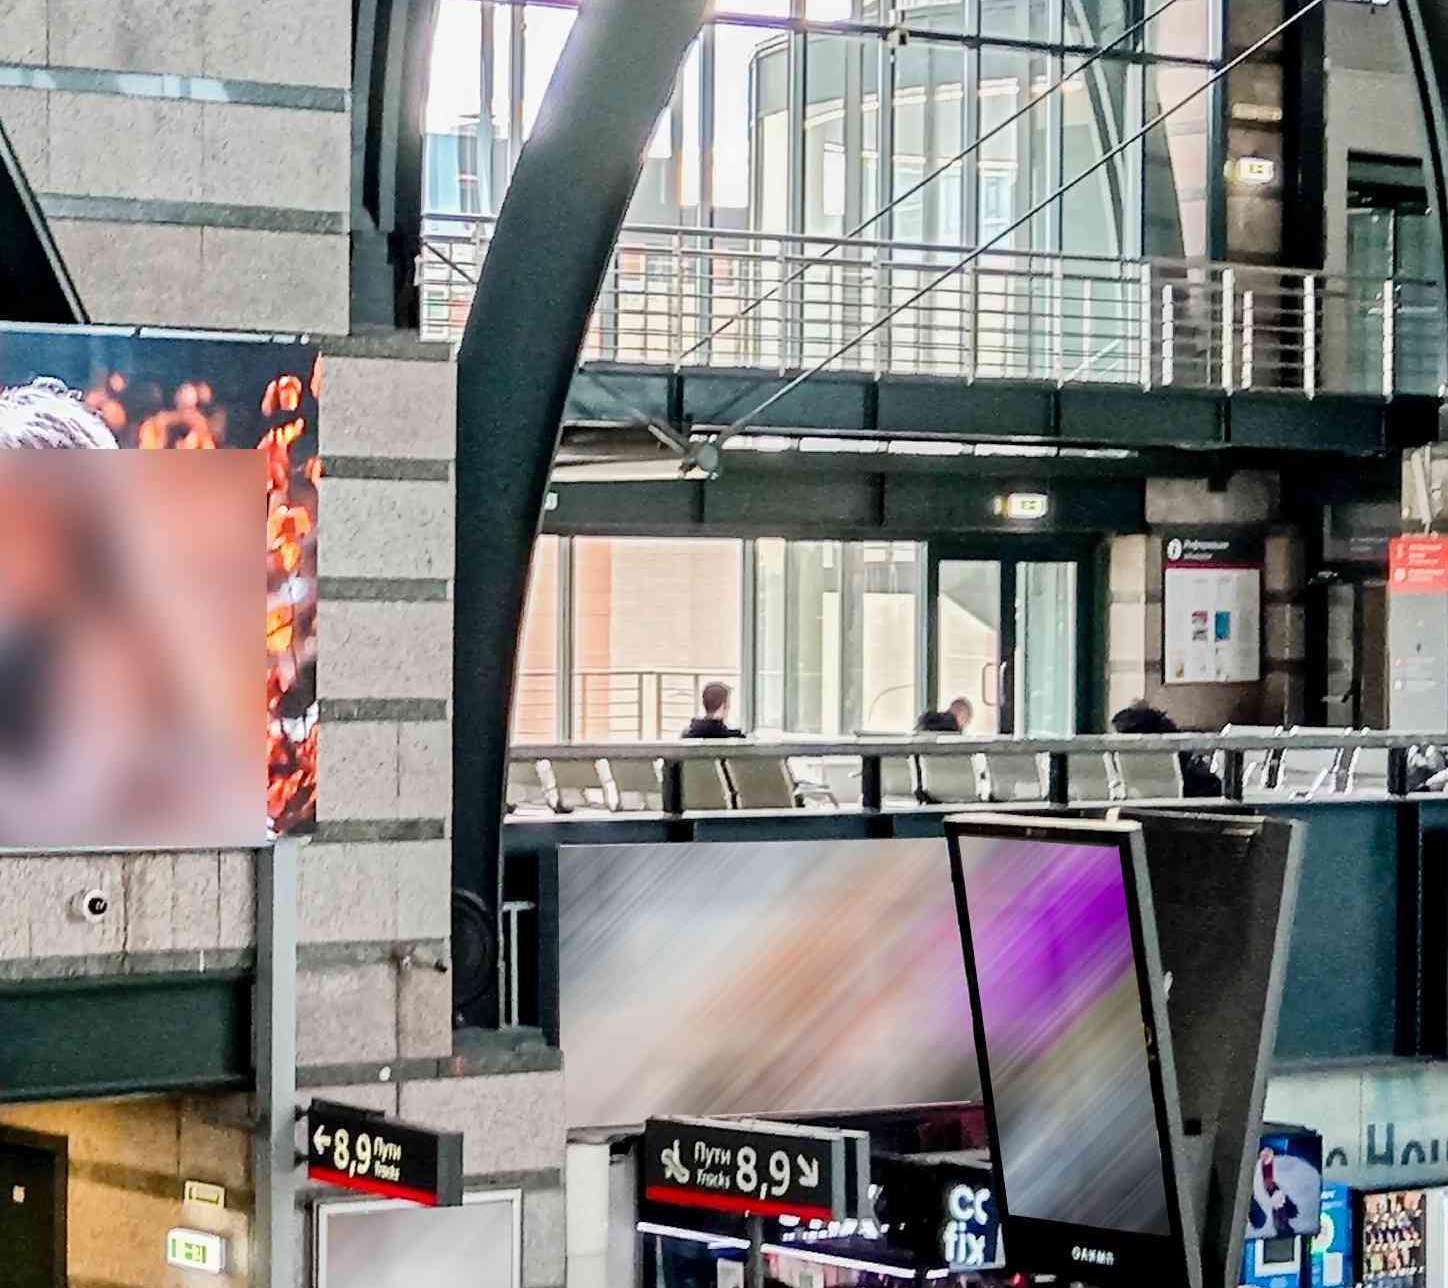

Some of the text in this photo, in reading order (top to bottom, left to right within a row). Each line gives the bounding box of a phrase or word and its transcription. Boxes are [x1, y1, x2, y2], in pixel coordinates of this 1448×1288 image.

[334, 1128, 402, 1178] 8,9 Пути
[694, 1141, 790, 1200] Пути 8,9
